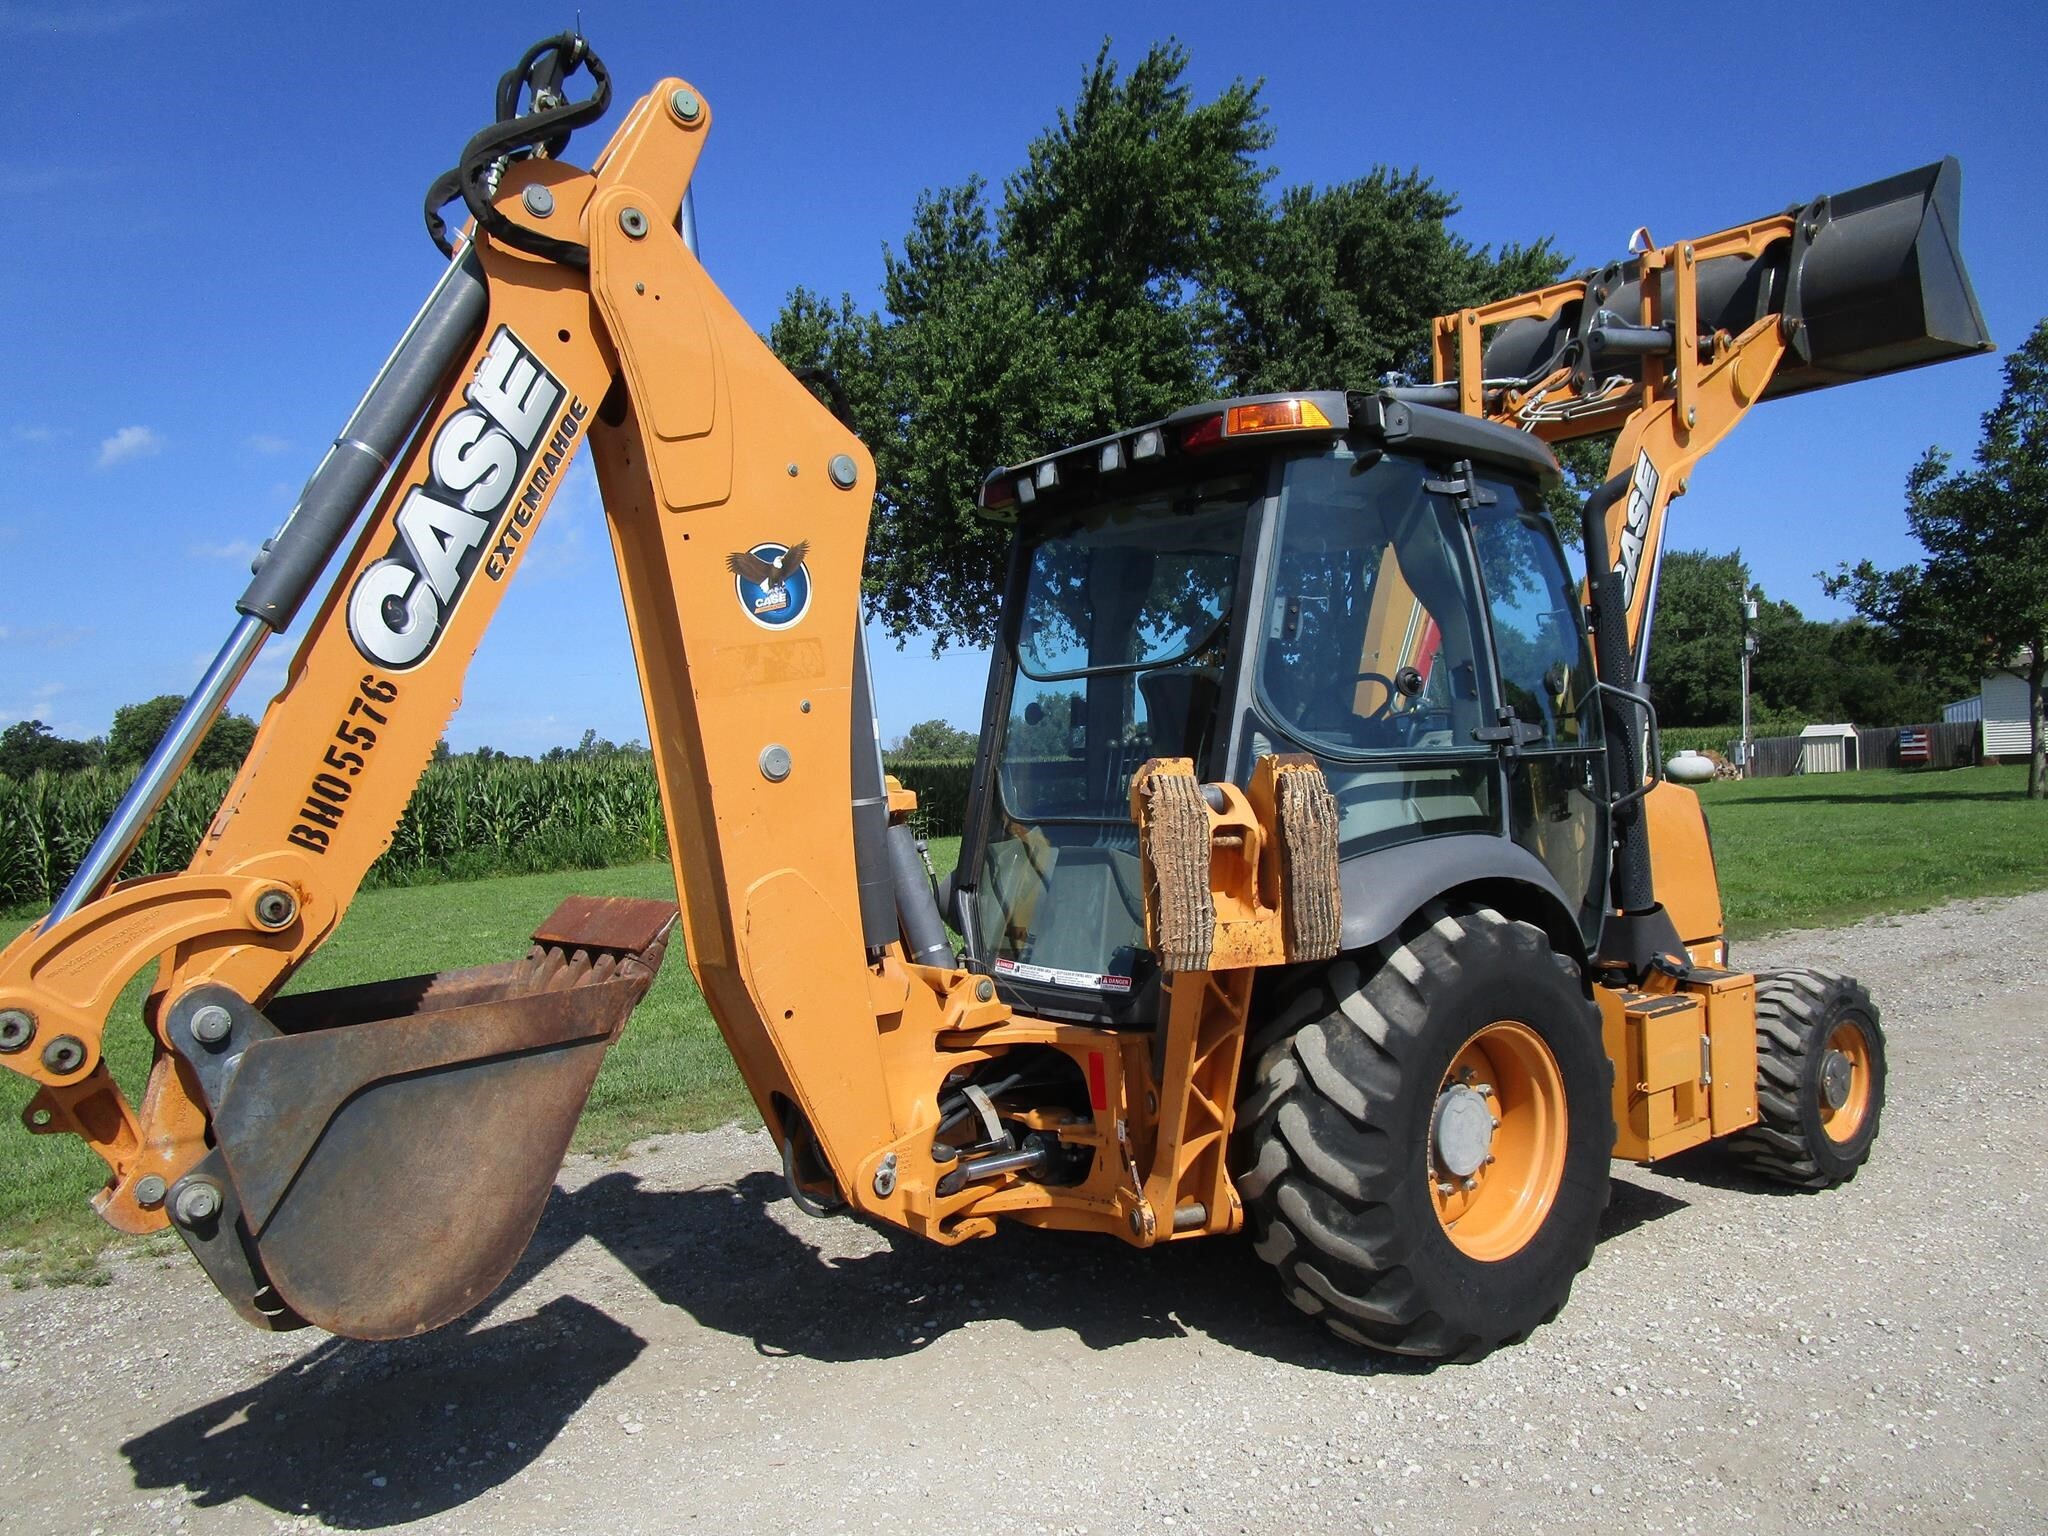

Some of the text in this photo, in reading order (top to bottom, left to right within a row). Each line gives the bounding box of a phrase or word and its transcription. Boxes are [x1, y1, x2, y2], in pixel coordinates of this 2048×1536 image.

[350, 327, 562, 667] CASE
[485, 395, 588, 582] EXTENDAHOE
[756, 593, 786, 607] CASE
[1110, 978, 1129, 986] DANGER
